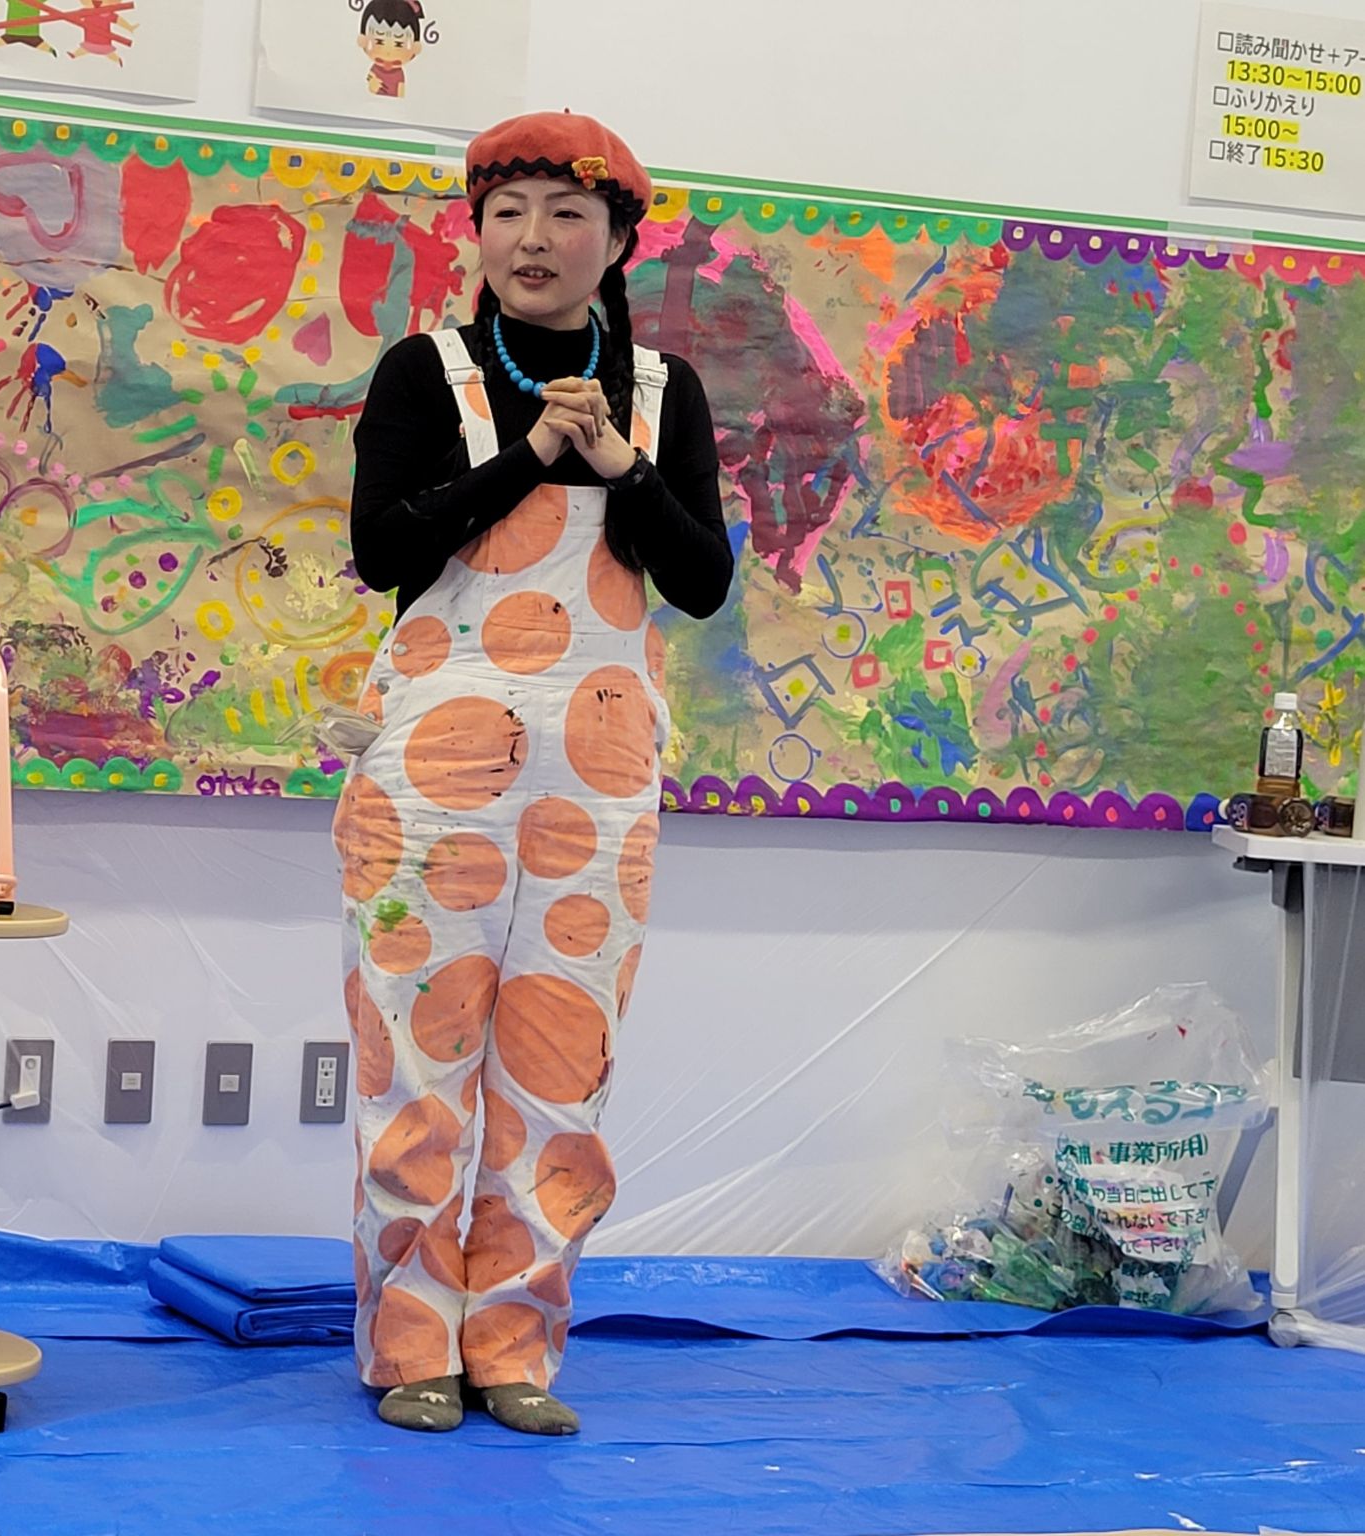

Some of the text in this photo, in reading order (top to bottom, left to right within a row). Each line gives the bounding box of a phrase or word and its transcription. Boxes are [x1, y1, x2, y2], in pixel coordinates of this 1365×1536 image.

[1230, 87, 1316, 118] ふりかえり
